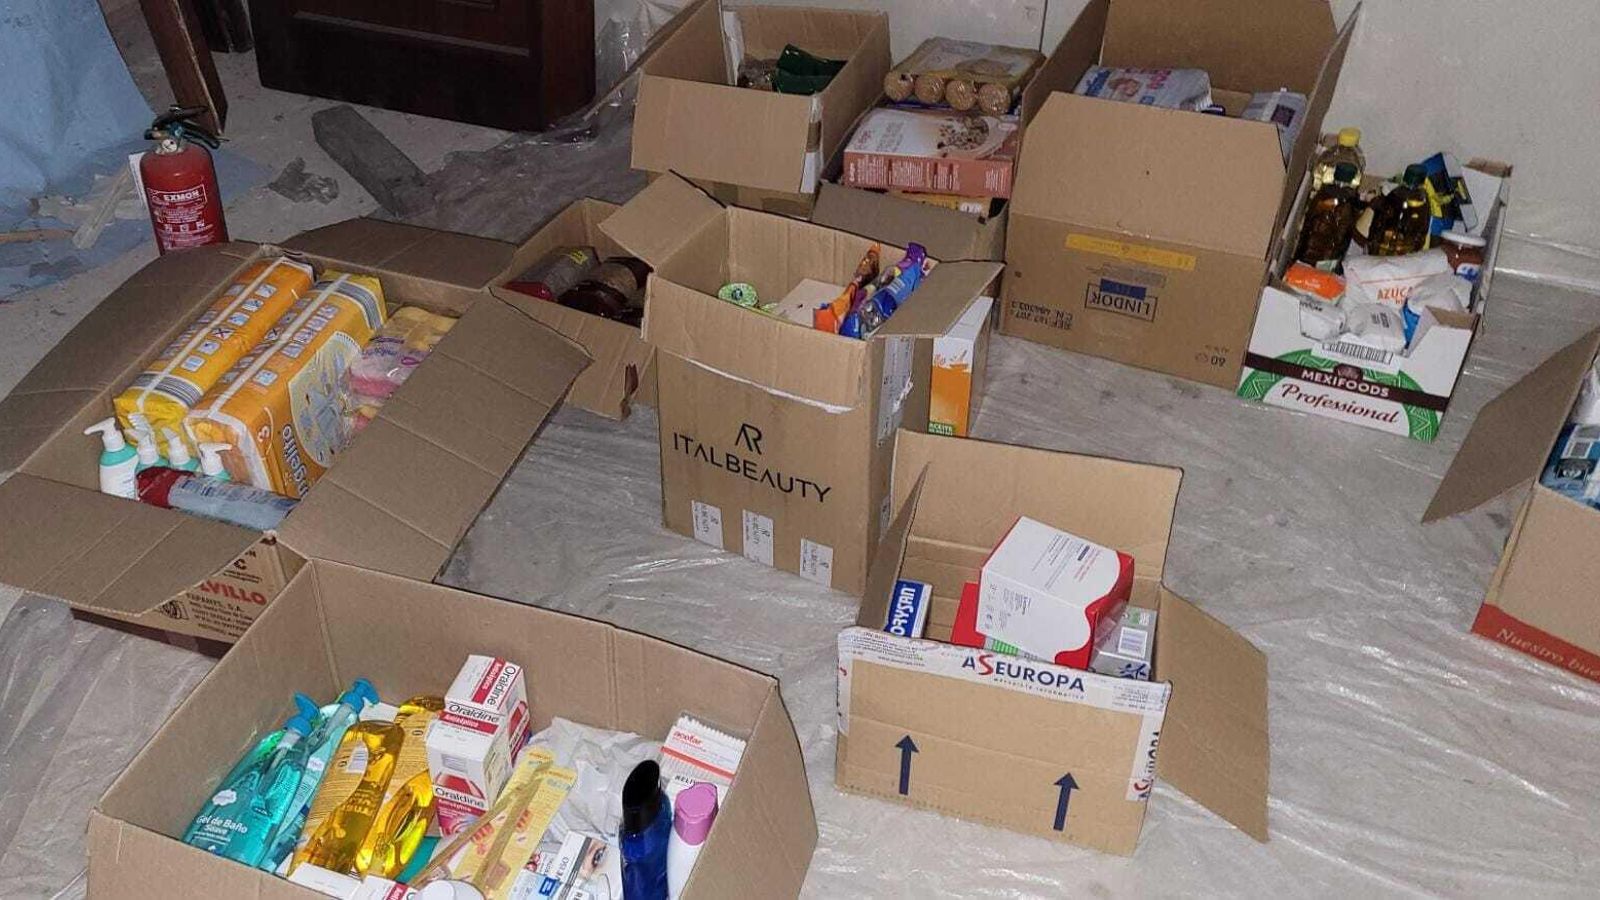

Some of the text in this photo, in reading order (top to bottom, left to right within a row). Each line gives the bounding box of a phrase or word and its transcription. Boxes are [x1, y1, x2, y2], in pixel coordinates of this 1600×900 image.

[163, 190, 200, 201] EXMON
[1091, 293, 1151, 316] LINDOR
[1377, 286, 1410, 300] AZUC
[1301, 368, 1390, 398] MEXIFOODS
[1282, 382, 1400, 425] Professional
[673, 432, 832, 503] ITALBEAUTY
[1496, 628, 1564, 662] Nuestro
[961, 652, 1085, 693] ASEUROPA
[487, 665, 516, 705] Oraldine
[448, 703, 500, 723] Oraldine
[673, 730, 703, 745] acofar
[434, 786, 486, 809] Oraldine
[196, 813, 249, 835] Gel de Baño
[204, 823, 229, 836] Suave
